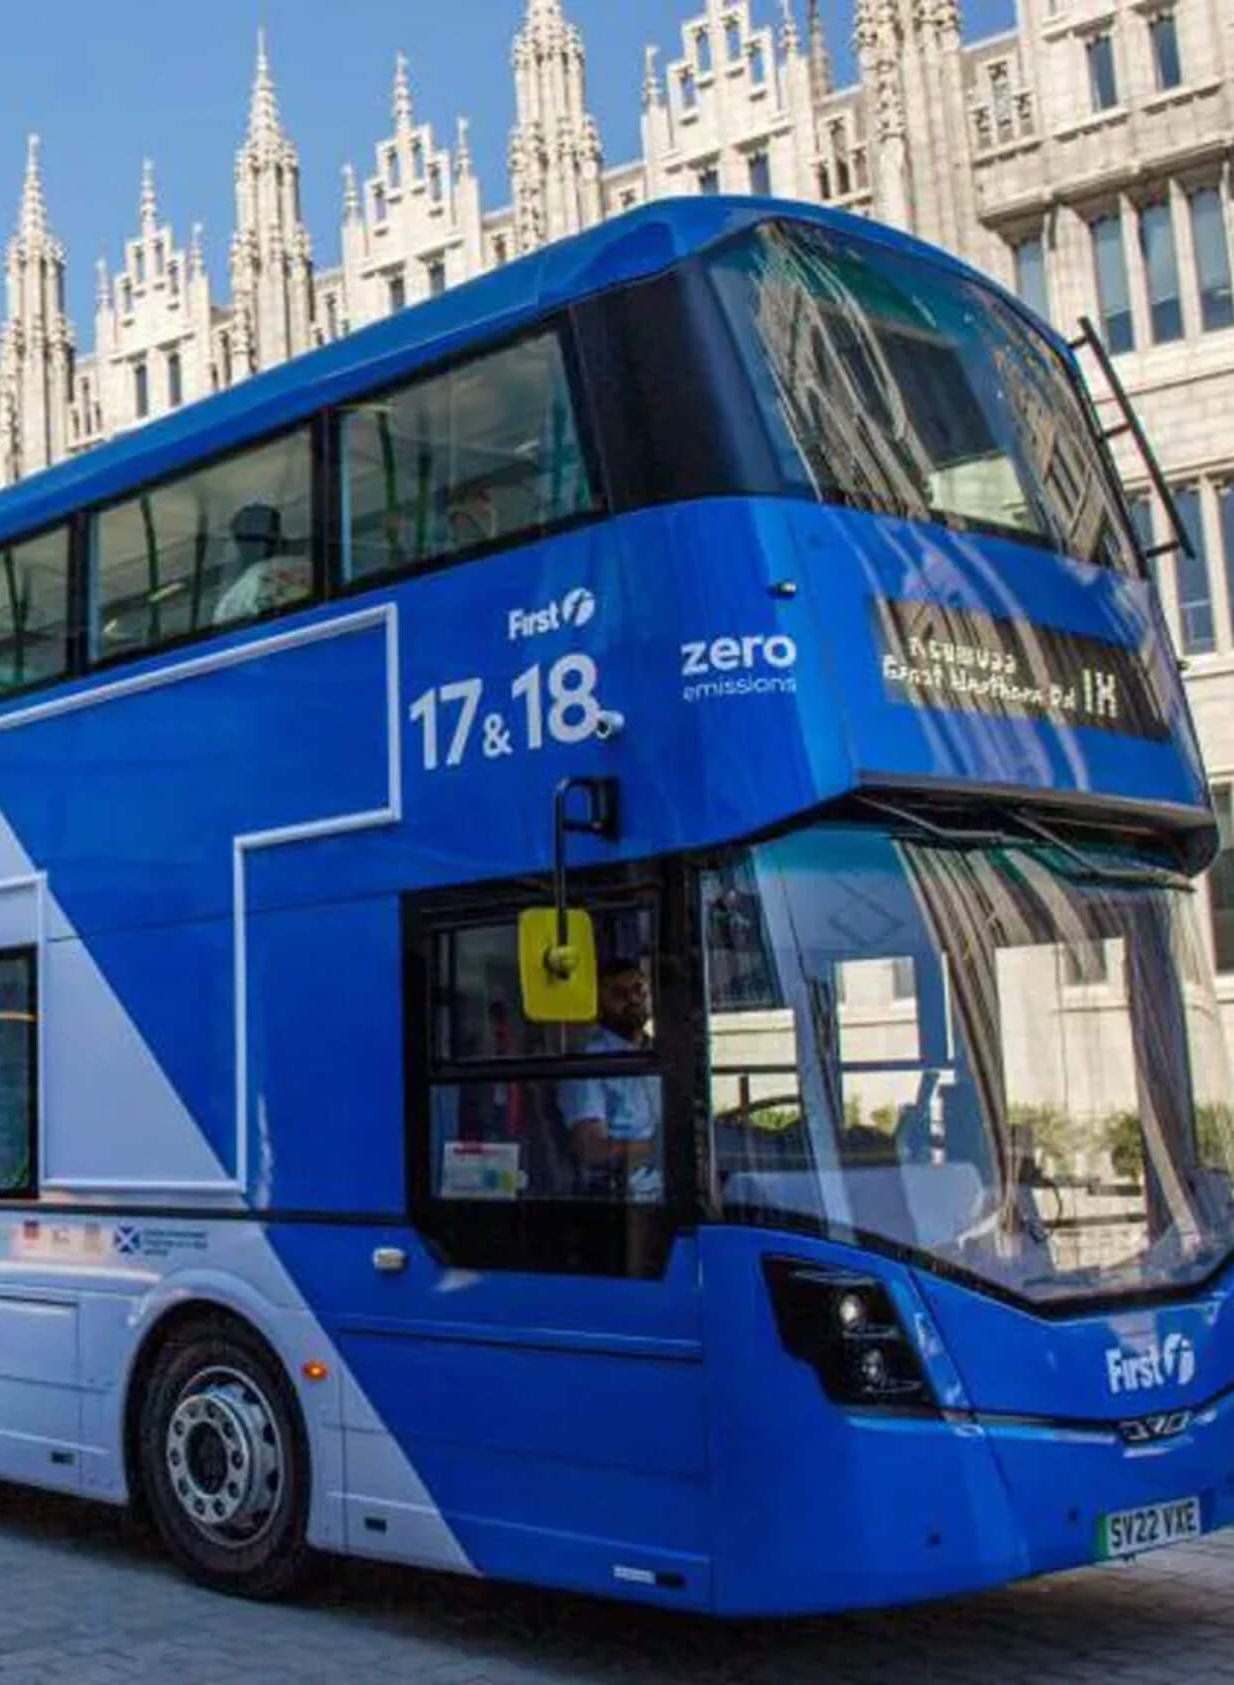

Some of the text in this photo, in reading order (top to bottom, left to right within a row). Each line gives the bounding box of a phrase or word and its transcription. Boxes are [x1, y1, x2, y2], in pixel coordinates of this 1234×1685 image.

[508, 602, 560, 640] First
[680, 634, 797, 677] zero
[682, 678, 797, 702] emissions
[1104, 1344, 1164, 1394] First
[1110, 1500, 1197, 1548] SV22 VXE
